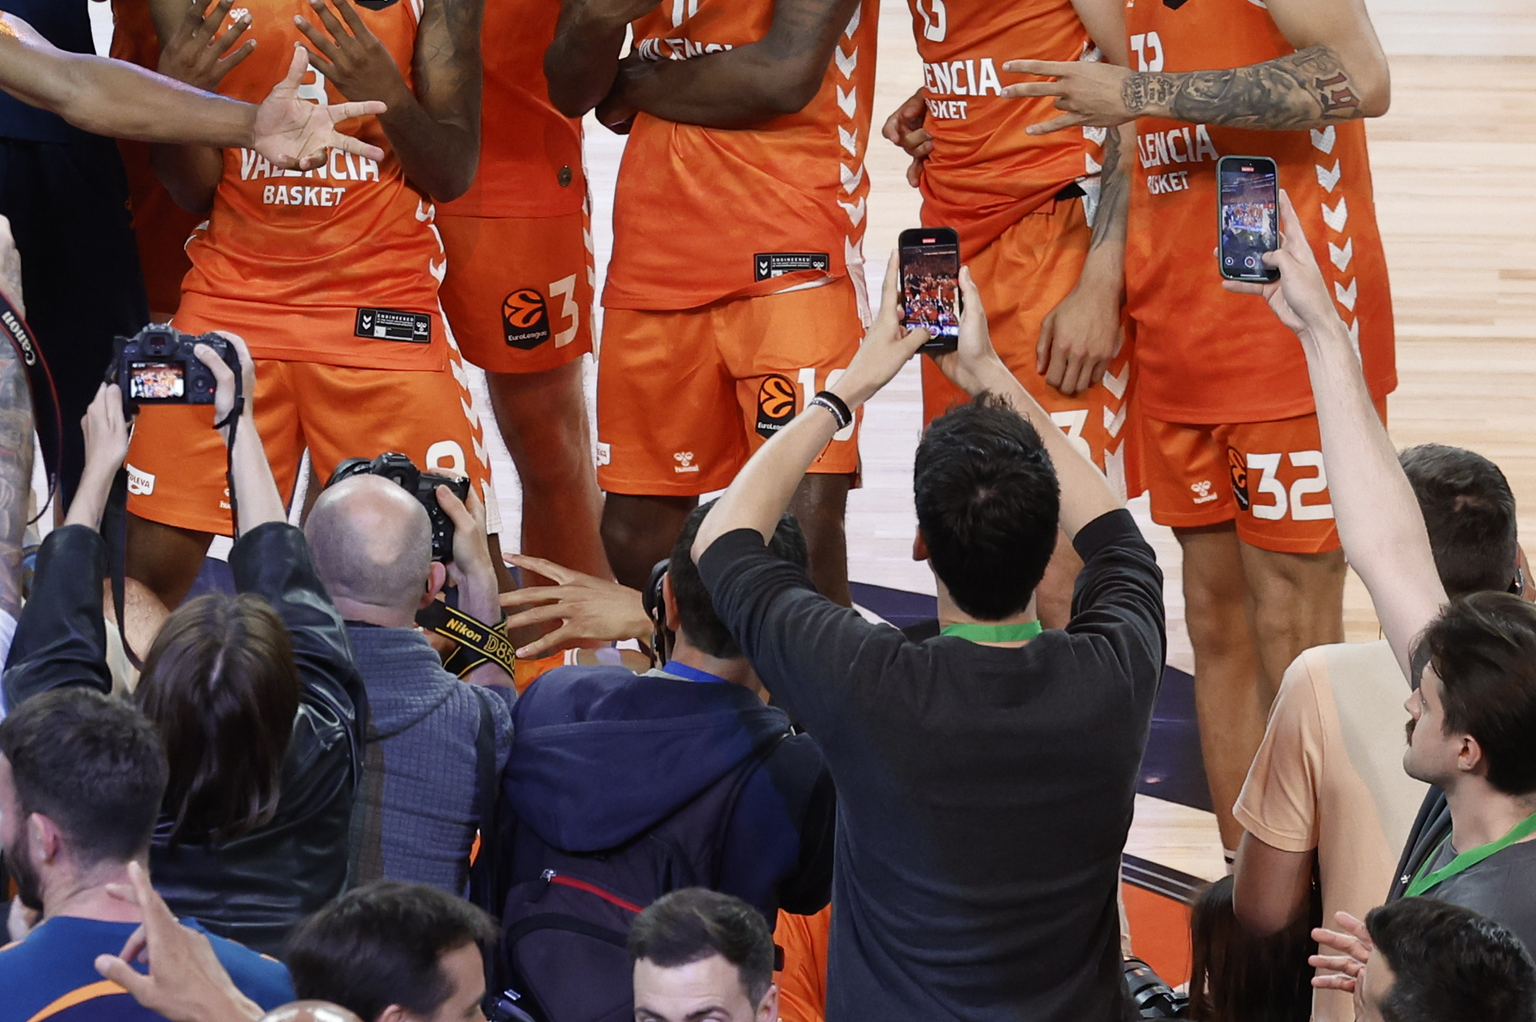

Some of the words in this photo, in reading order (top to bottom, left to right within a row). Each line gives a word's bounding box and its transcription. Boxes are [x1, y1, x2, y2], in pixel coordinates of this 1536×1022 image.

[924, 58, 1002, 96] ENCIA
[1137, 124, 1219, 169] LENCIA
[263, 185, 347, 206] BASKET
[549, 274, 578, 348] 3
[1, 310, 36, 366] Canon
[508, 331, 548, 342] EuroLeague
[758, 421, 784, 431] EuroLea
[1246, 450, 1334, 521] 32
[446, 618, 482, 643] Nikon
